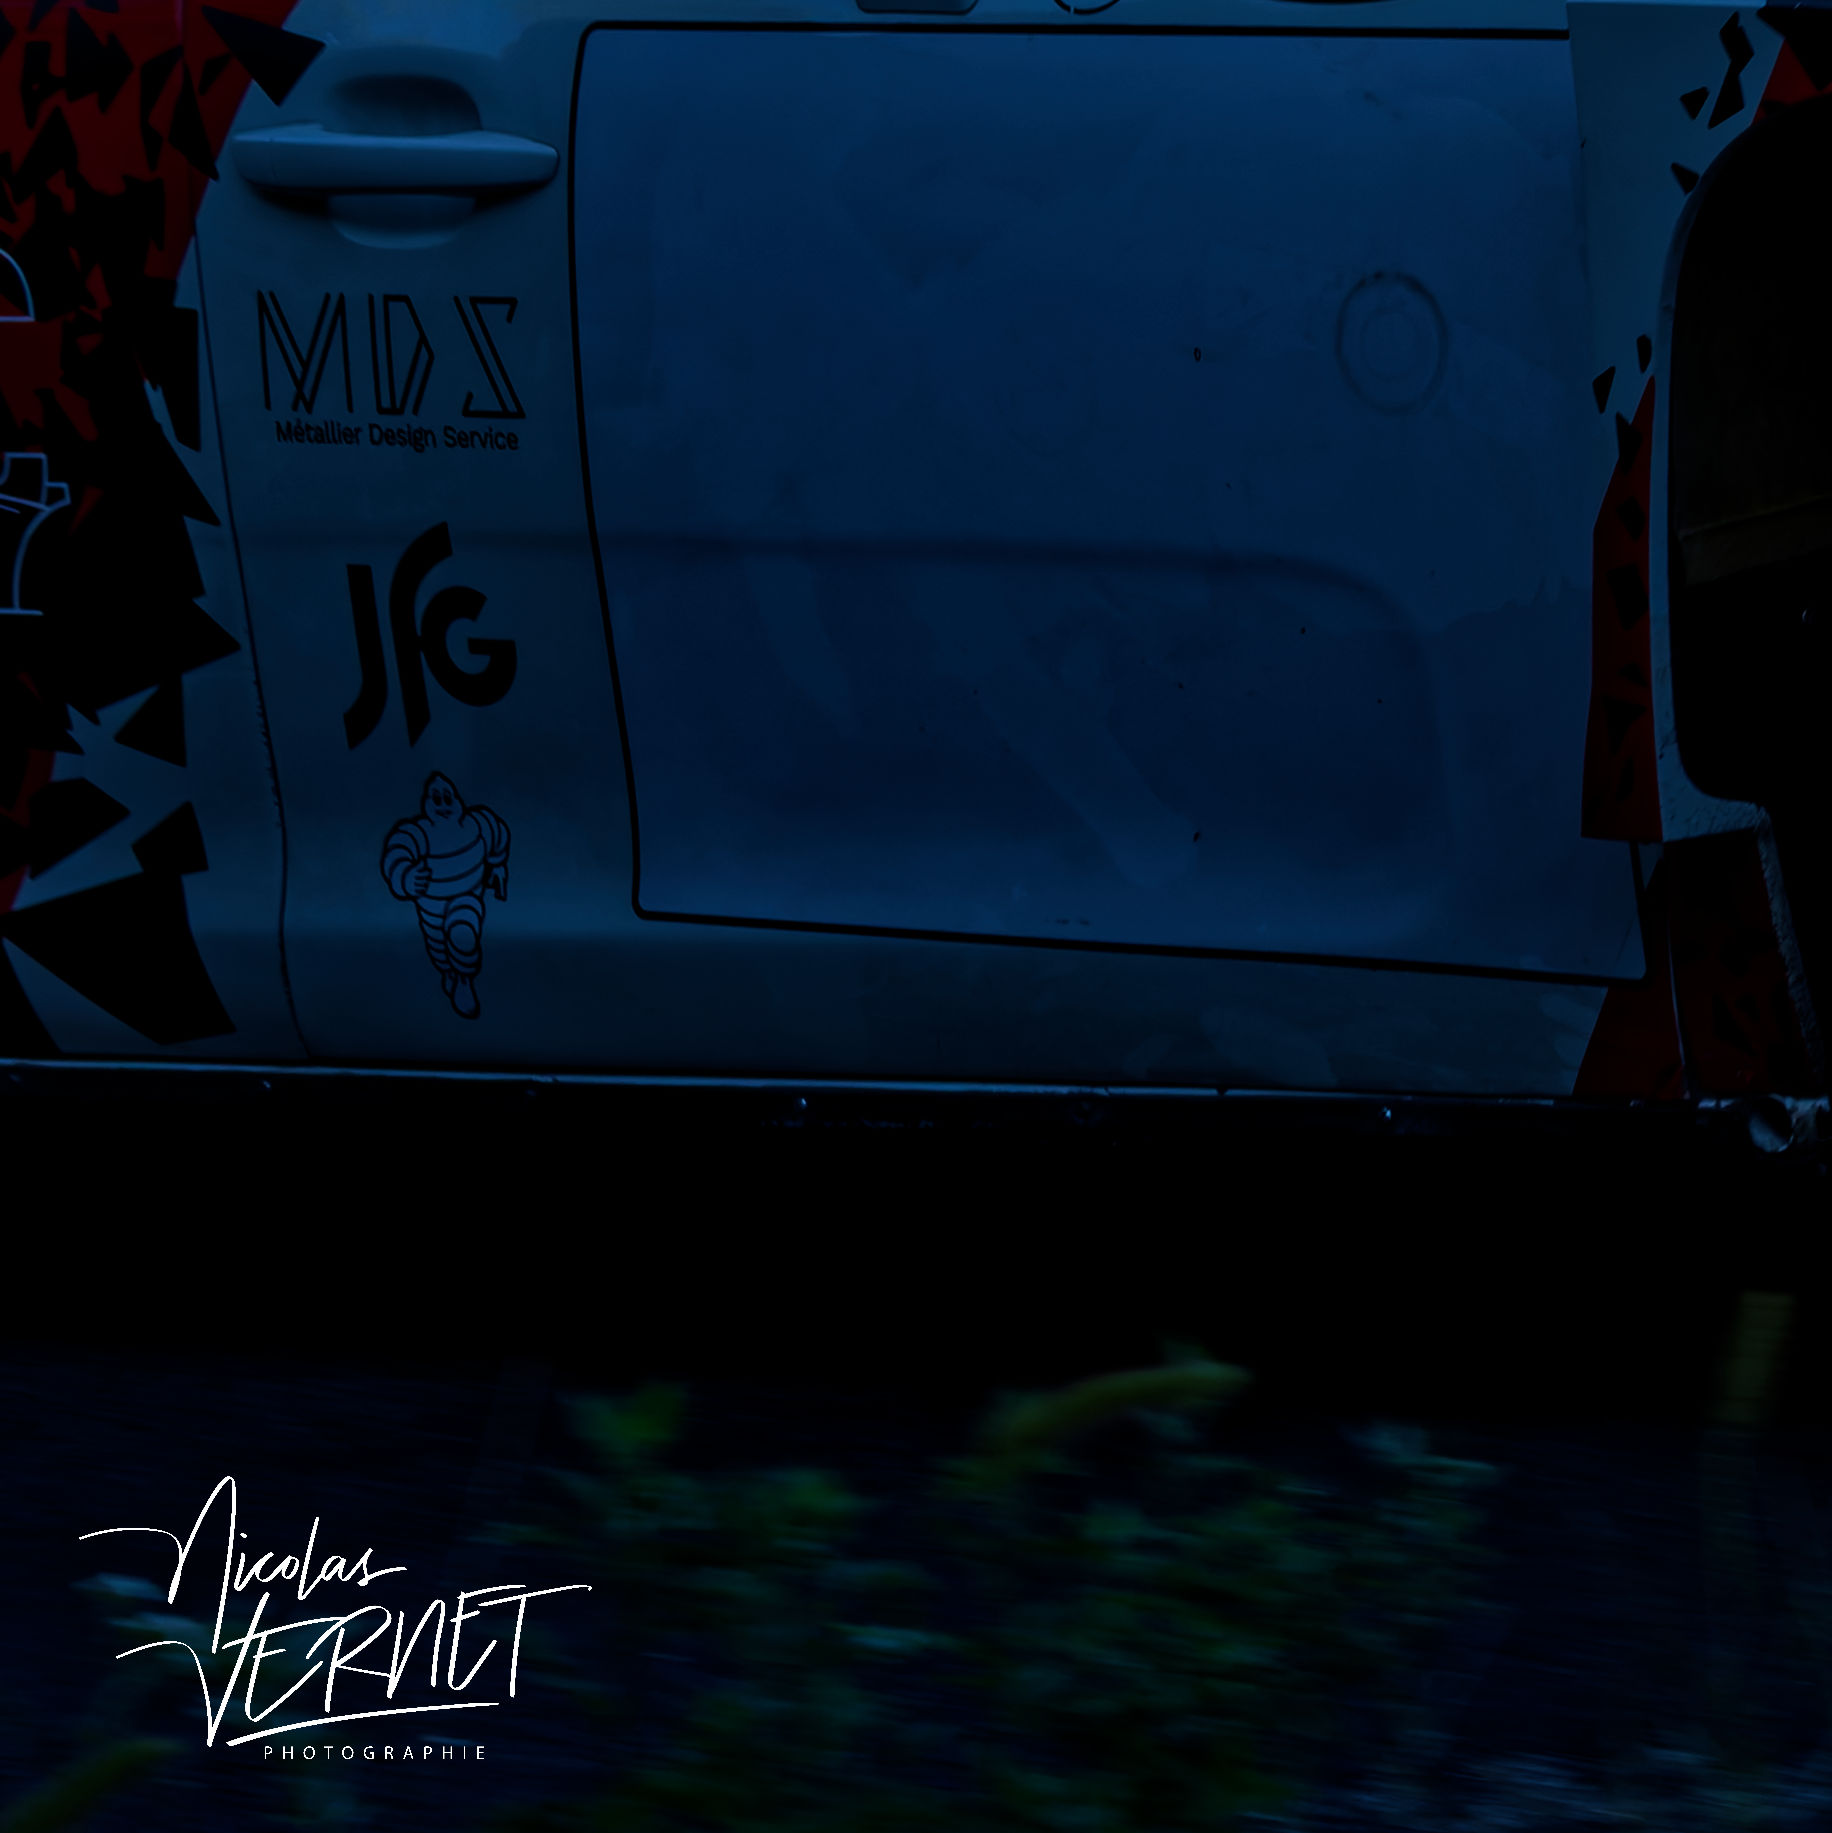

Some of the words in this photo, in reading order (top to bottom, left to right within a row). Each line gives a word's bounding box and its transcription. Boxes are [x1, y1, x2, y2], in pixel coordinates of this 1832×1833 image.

[276, 419, 361, 444] Métallier
[368, 423, 437, 453] Design
[443, 425, 520, 451] Service
